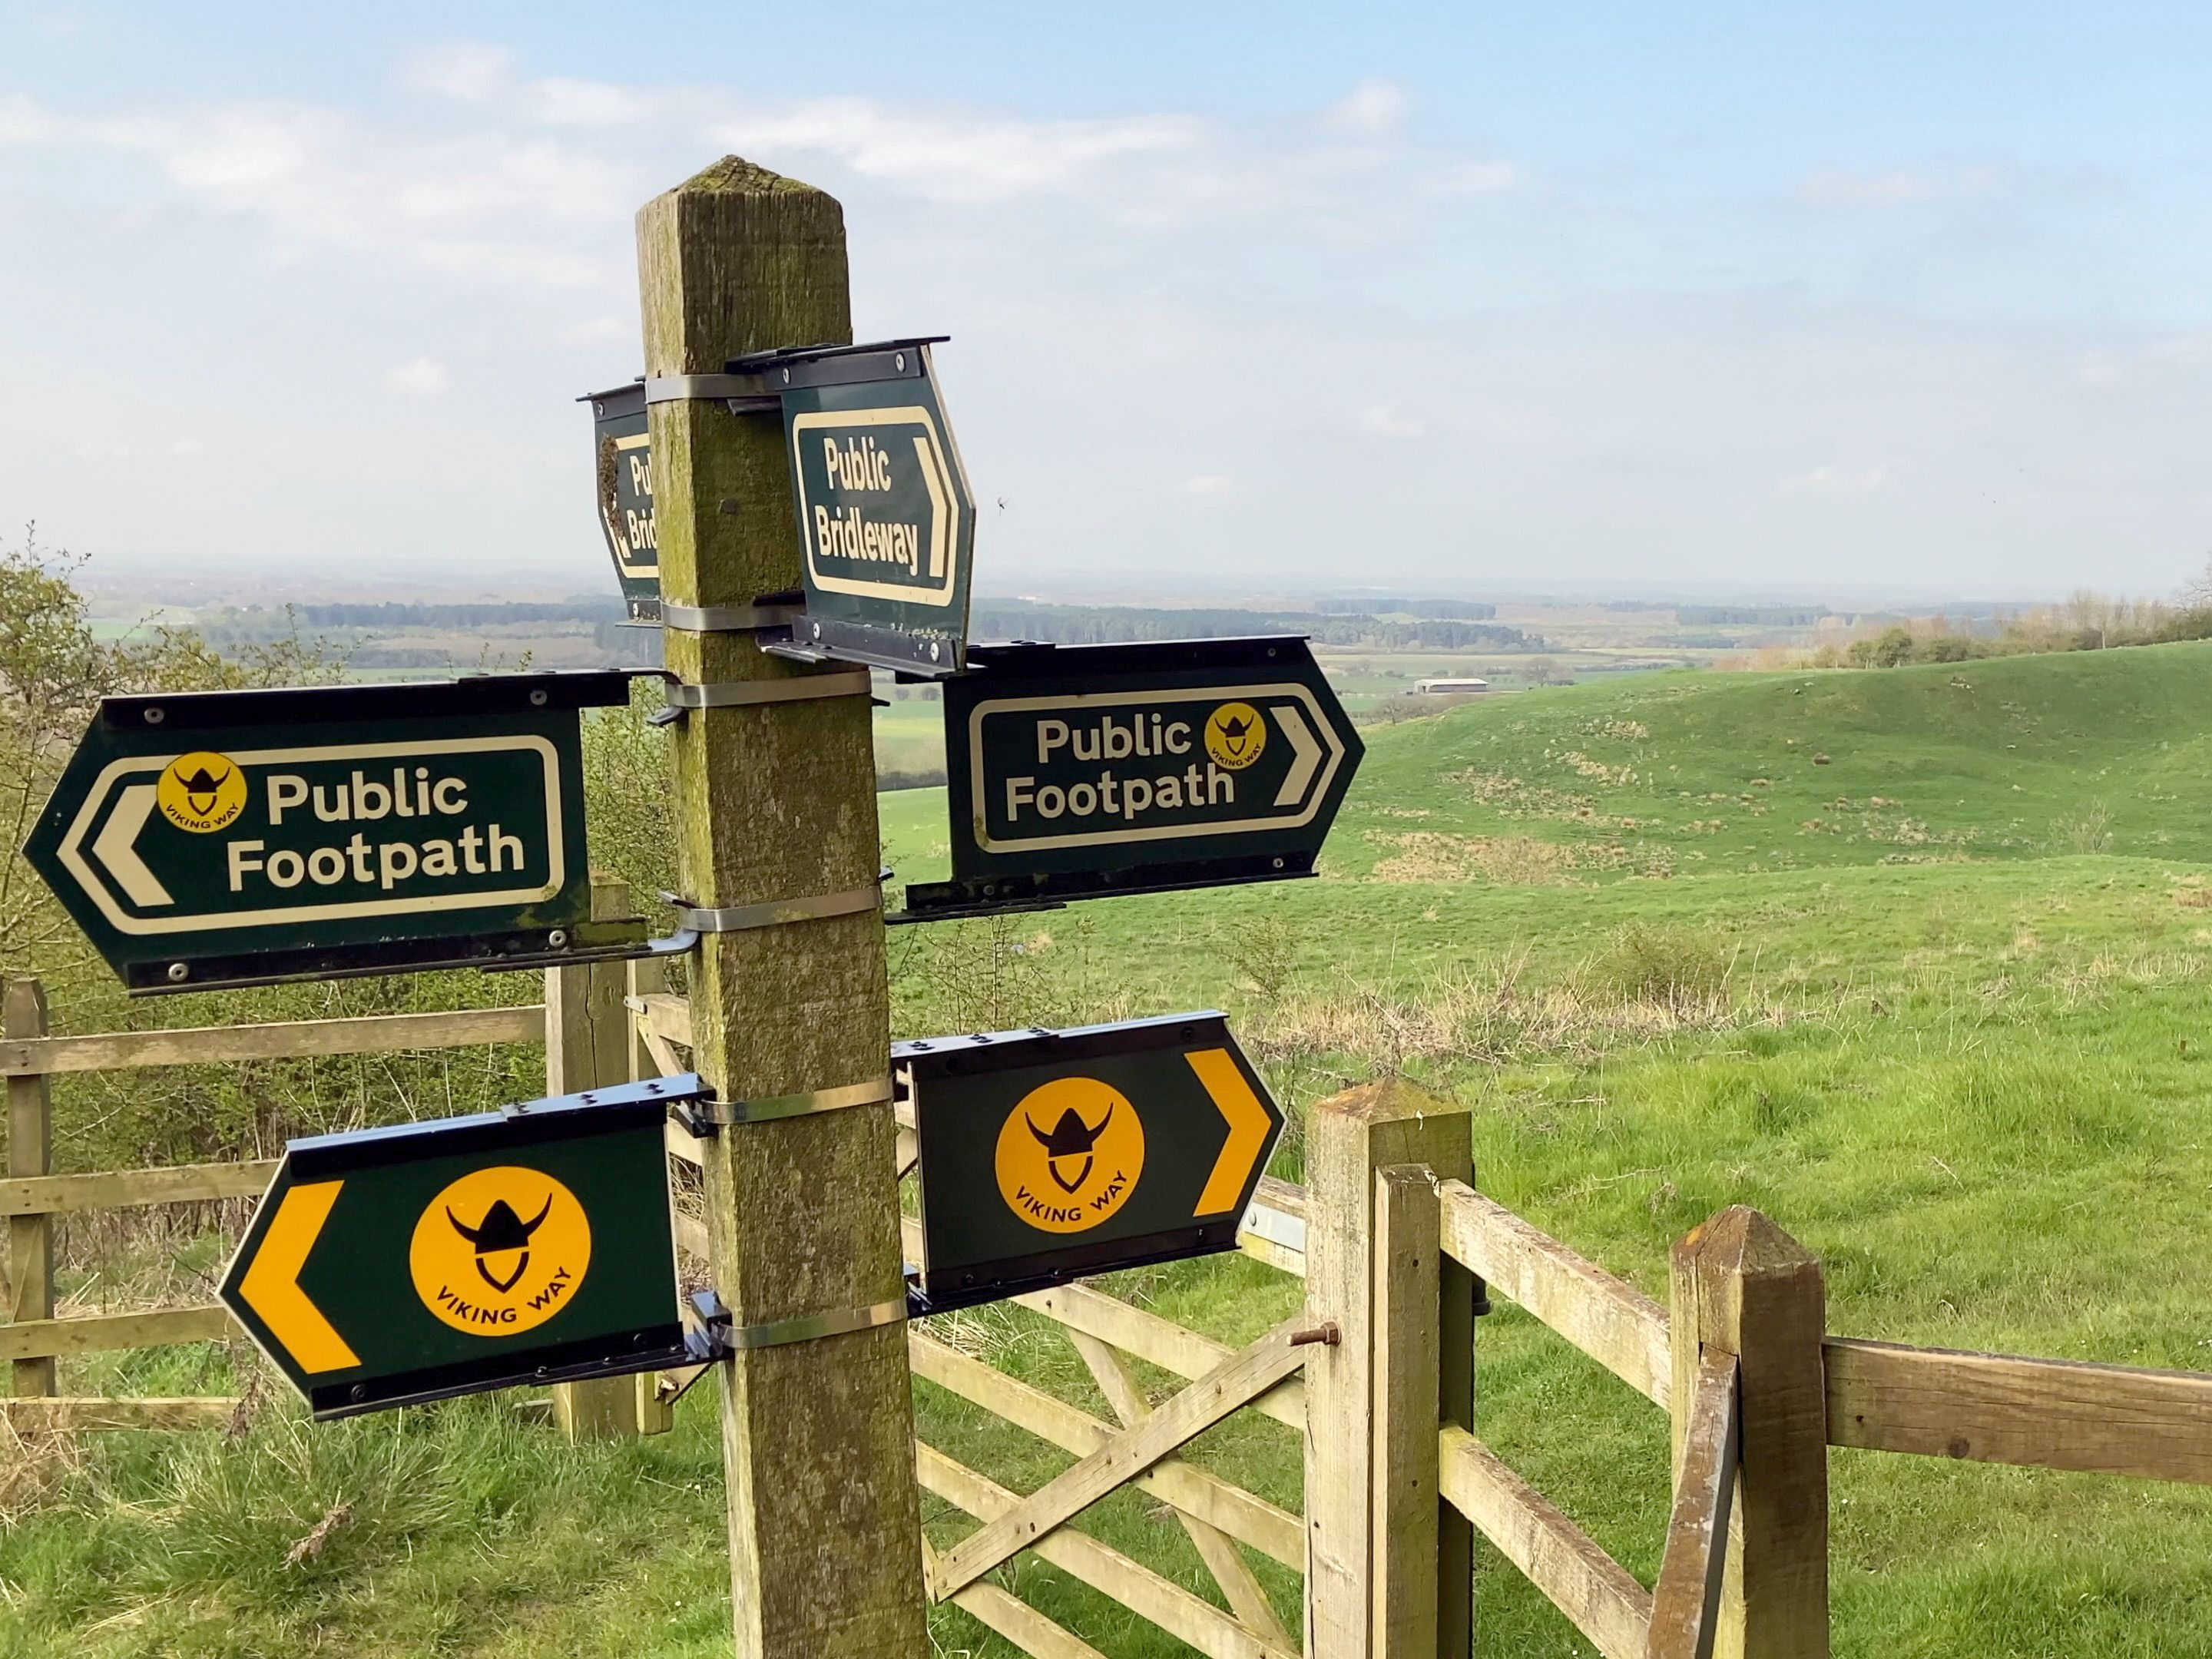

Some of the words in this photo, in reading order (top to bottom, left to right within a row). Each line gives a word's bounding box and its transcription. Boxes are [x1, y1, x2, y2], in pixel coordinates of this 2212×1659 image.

[823, 435, 892, 492] Public
[814, 505, 919, 577] Bridleway
[1037, 713, 1192, 763] Public
[1210, 746, 1243, 767] VIKING
[1243, 742, 1262, 763] WAY
[166, 803, 211, 829] VIKING
[213, 802, 239, 826] WAY
[267, 767, 468, 825] Public
[1006, 761, 1235, 821] Footpath
[227, 823, 525, 892] Footpath
[1015, 1185, 1081, 1223] VIKING
[1089, 1170, 1128, 1211] WAY
[436, 1284, 517, 1325] VIKING
[527, 1266, 571, 1311] WAY
